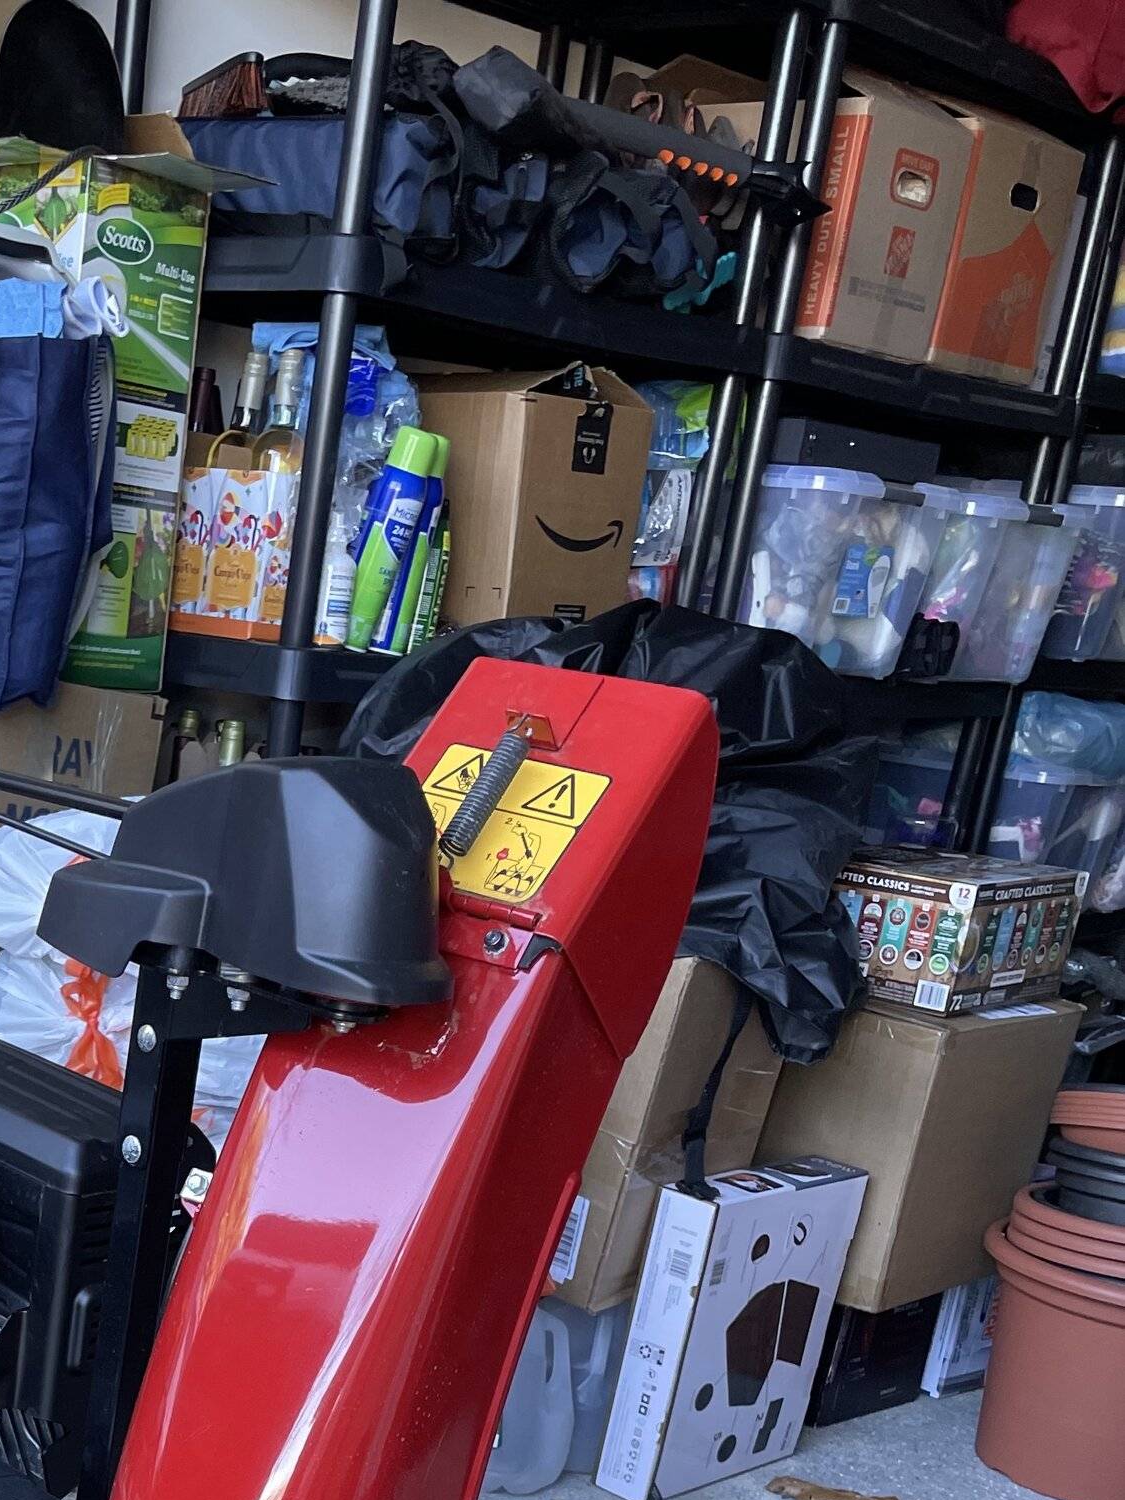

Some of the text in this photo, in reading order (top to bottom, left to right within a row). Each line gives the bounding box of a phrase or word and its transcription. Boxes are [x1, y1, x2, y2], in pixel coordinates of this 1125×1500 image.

[804, 258, 825, 315] HEAVY
[826, 126, 849, 199] SMALL
[102, 225, 147, 255] Scotts
[155, 262, 195, 284] Multi-Use
[866, 874, 911, 893] CLASSICS
[995, 887, 1024, 901] CRAFTED
[1024, 884, 1053, 898] CLASSICS
[958, 887, 971, 900] 12
[949, 994, 963, 1012] 72
